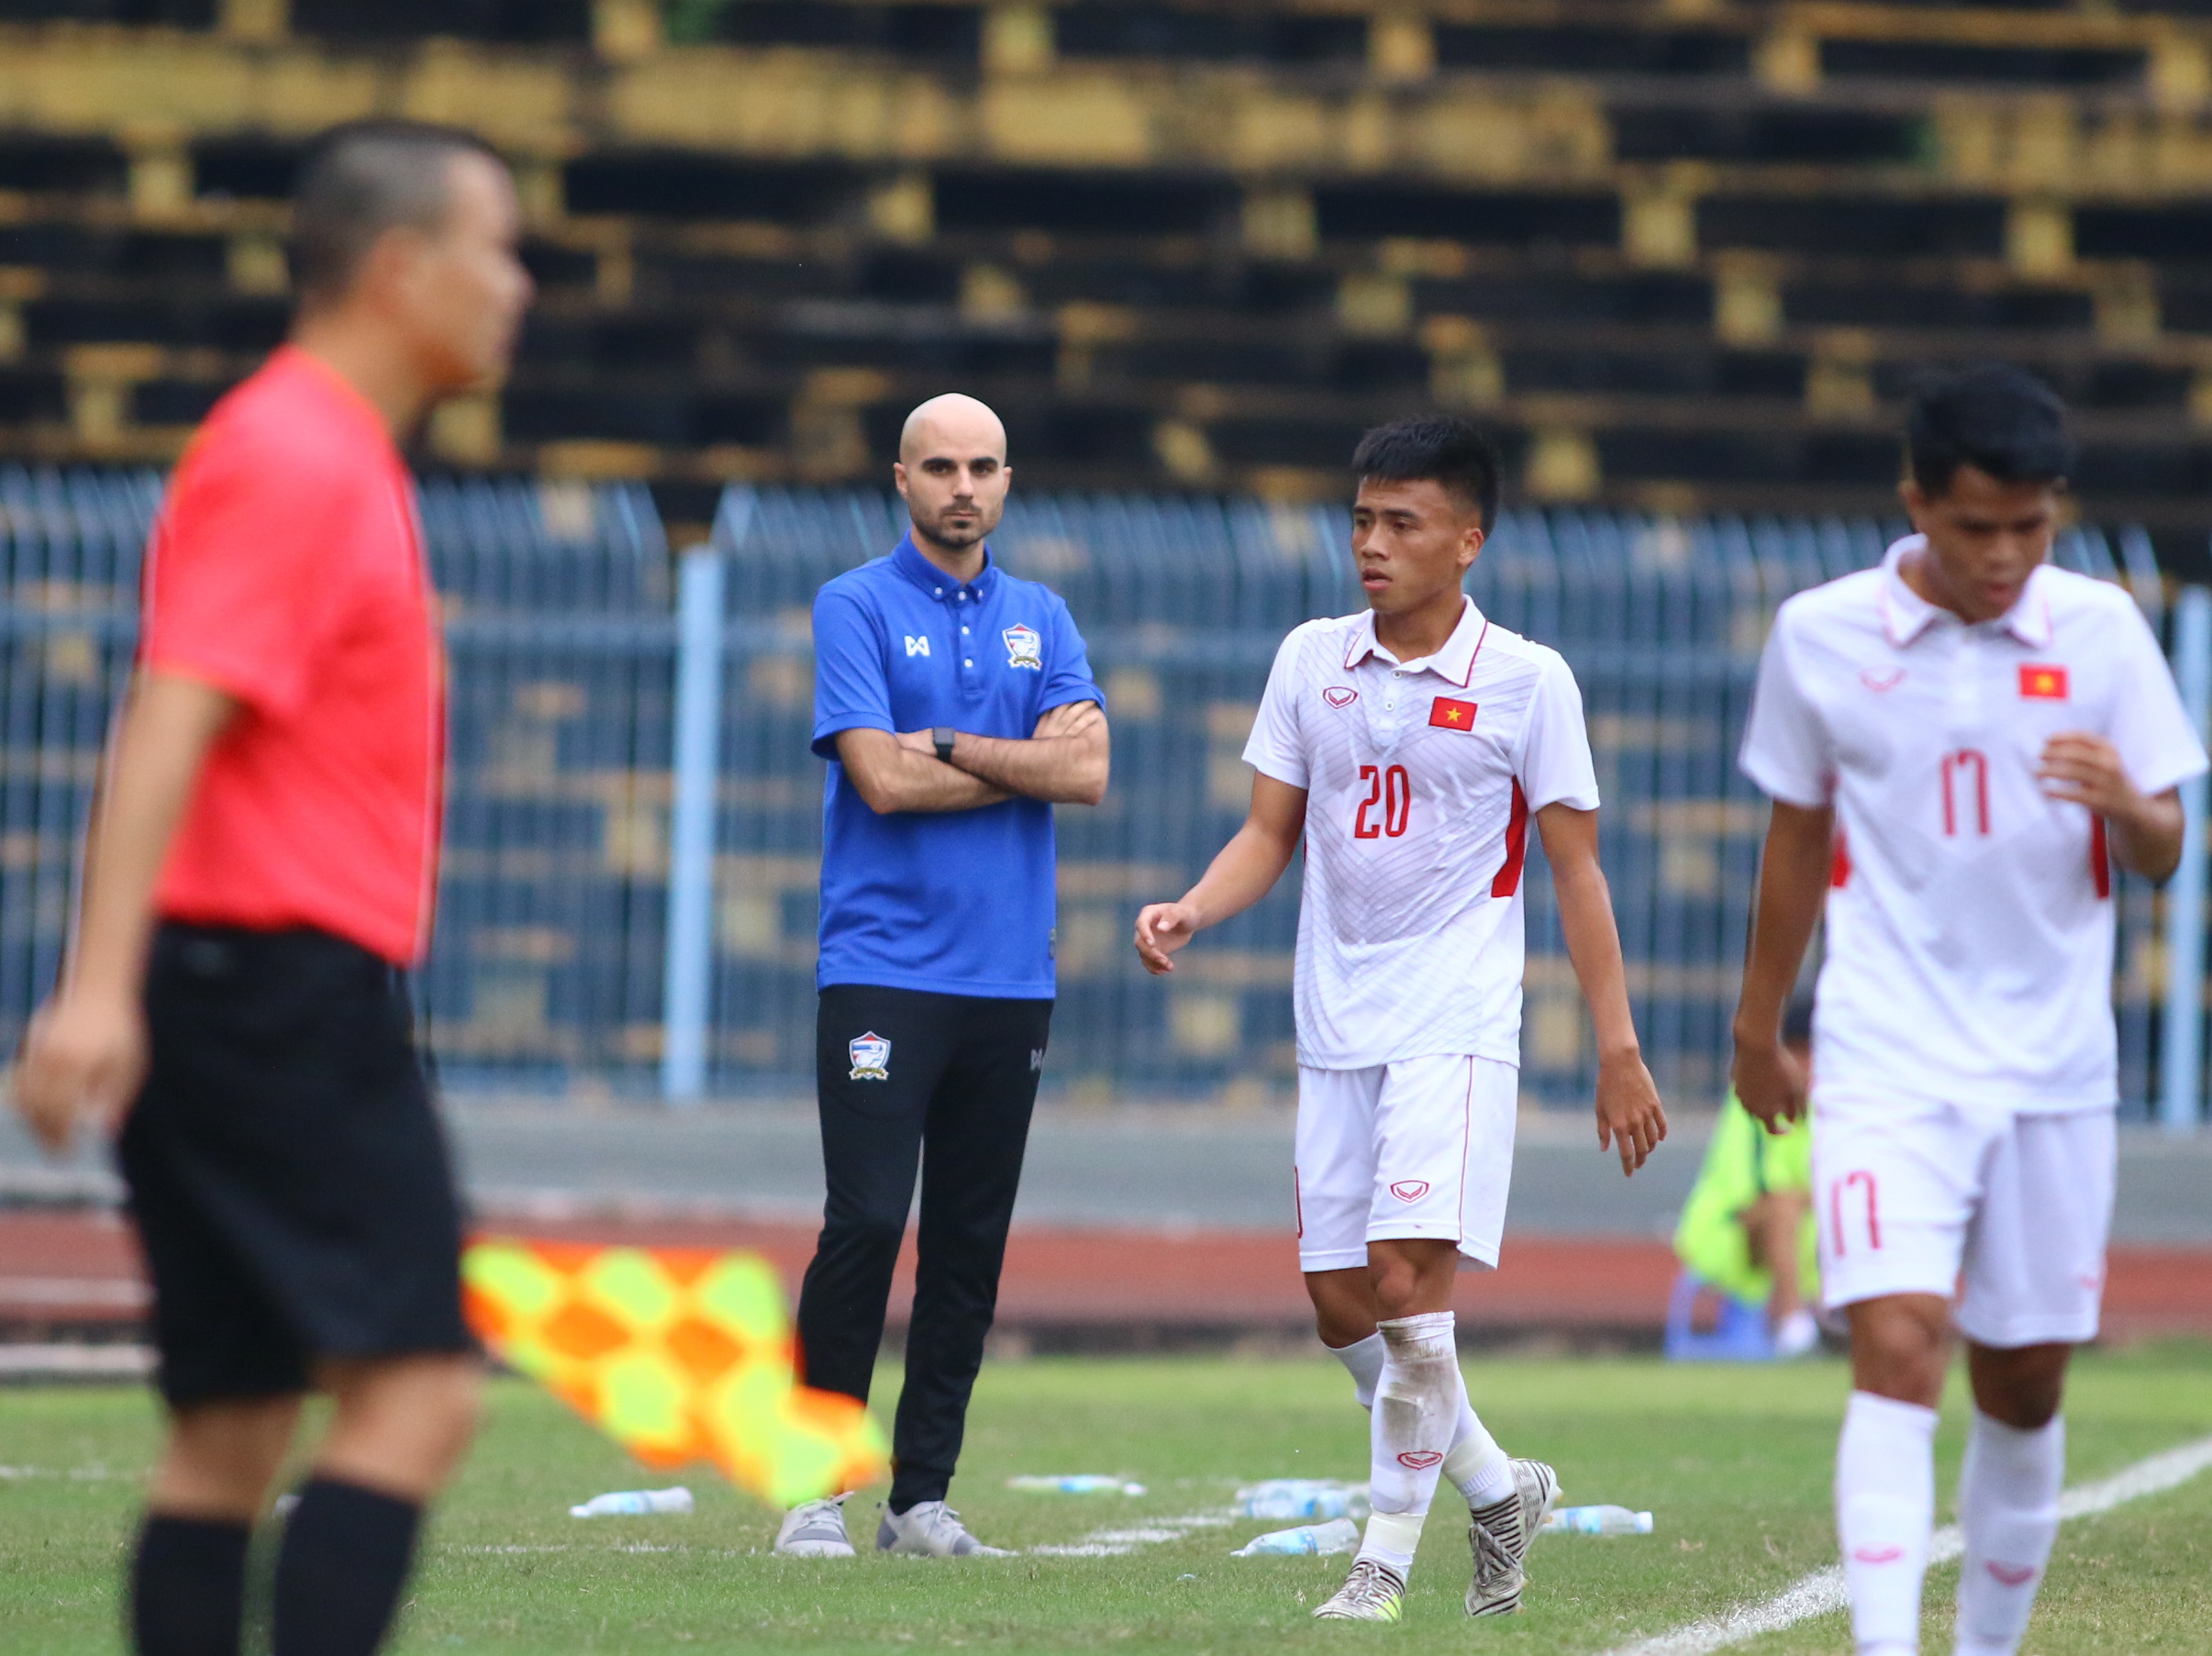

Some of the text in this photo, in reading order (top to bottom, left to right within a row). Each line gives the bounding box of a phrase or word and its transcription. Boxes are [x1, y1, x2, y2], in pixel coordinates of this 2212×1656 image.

[1354, 764, 1410, 839] 20
[1941, 749, 1990, 836] 17
[1831, 1171, 1882, 1256] 17
